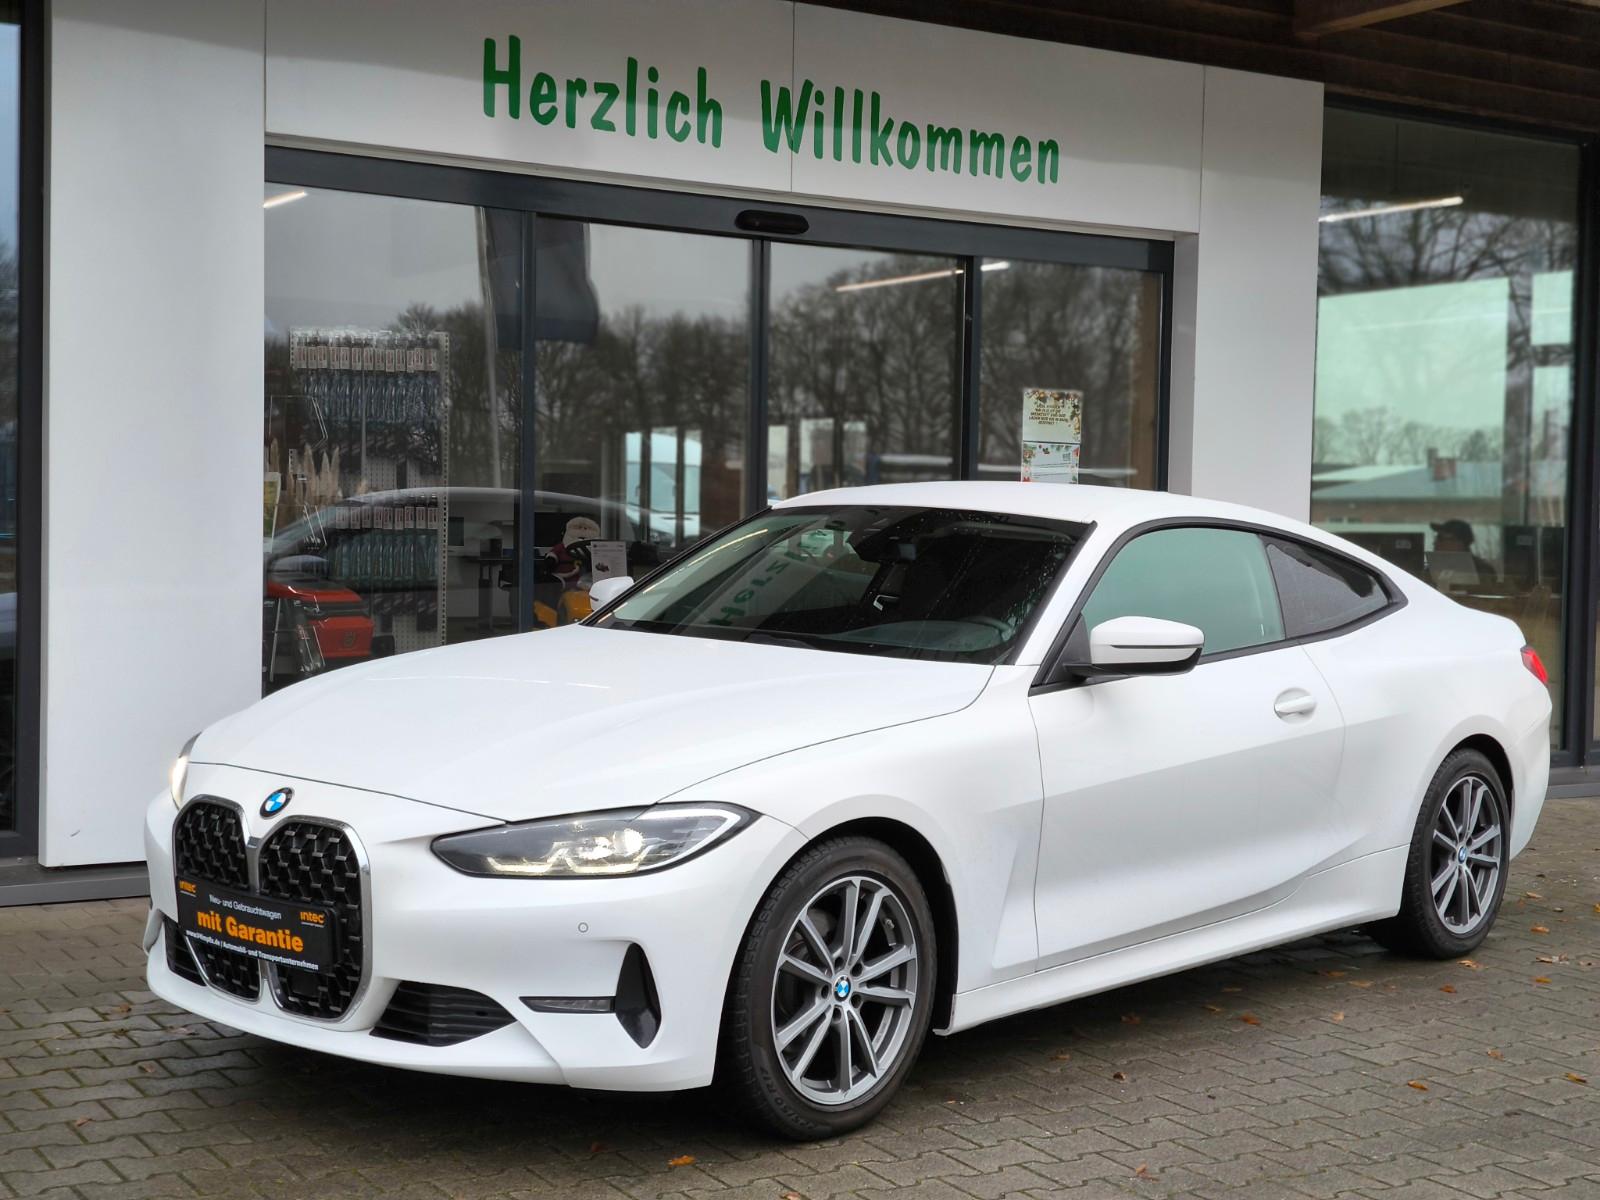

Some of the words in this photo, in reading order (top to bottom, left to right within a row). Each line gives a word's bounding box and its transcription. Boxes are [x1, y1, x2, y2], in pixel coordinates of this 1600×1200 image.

[484, 36, 722, 148] Herzlich
[761, 79, 1061, 185] Willkommen
[197, 910, 222, 933] mit
[225, 915, 304, 953] Garantie
[233, 900, 282, 920] Gebrauchtwagen
